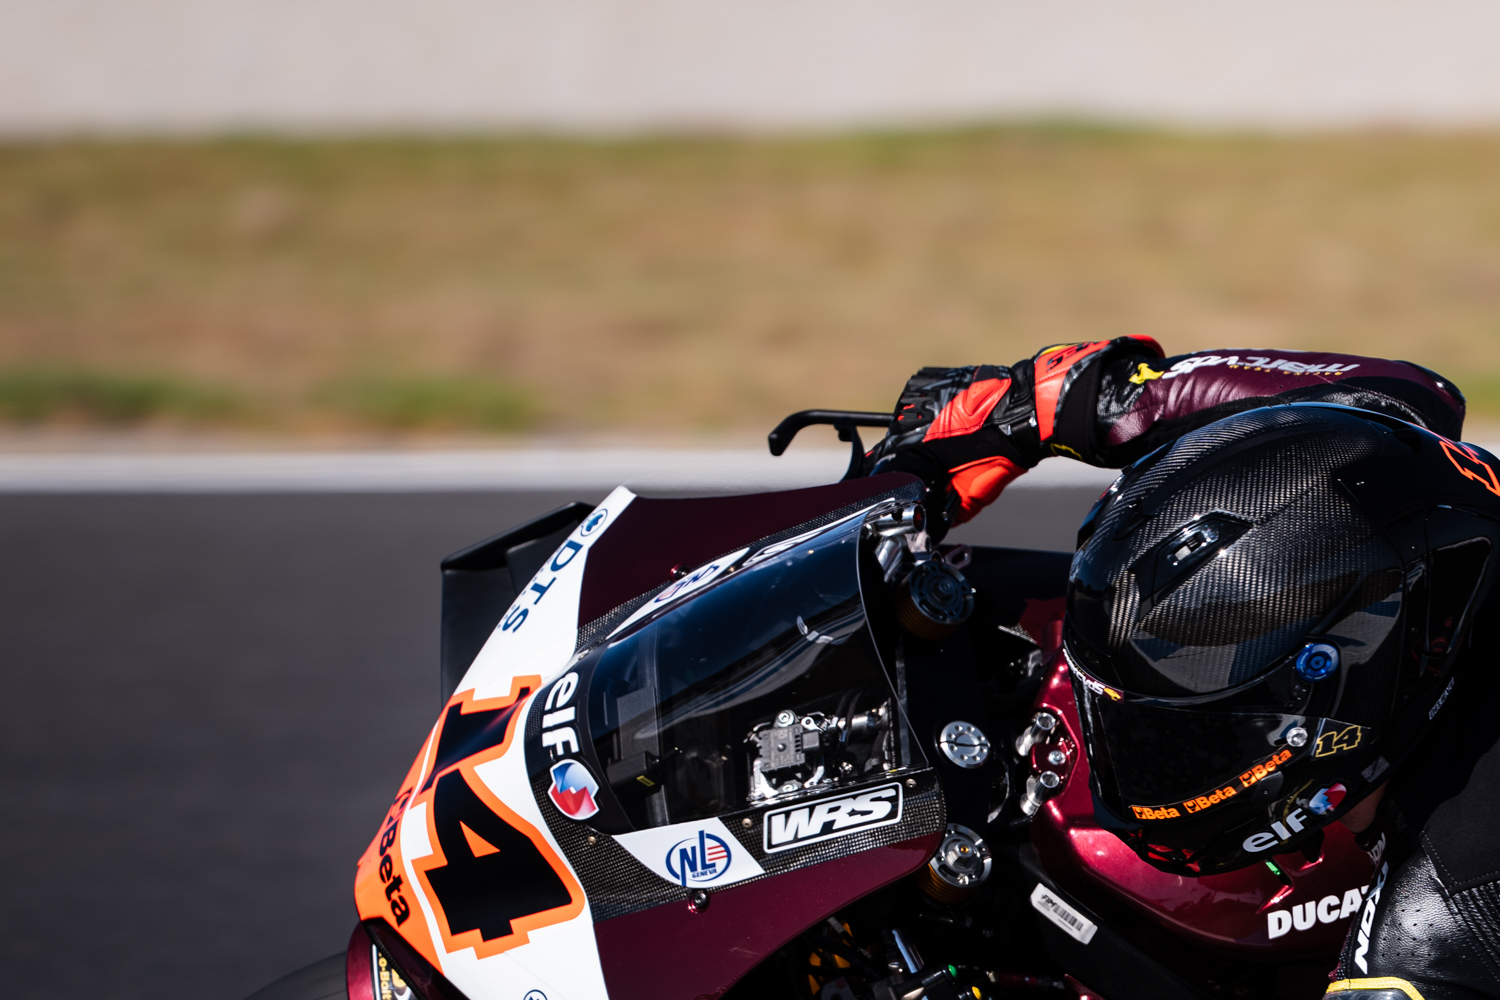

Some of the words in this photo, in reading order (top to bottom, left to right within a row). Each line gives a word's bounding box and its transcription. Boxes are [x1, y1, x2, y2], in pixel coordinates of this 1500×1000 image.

[501, 539, 584, 633] DTS
[541, 671, 581, 756] elf
[1252, 749, 1293, 780] Beta
[1315, 725, 1362, 758] 14
[415, 680, 578, 948] 14
[770, 788, 897, 846] WRS
[1145, 805, 1181, 820] Beta
[1198, 785, 1237, 809] Beta
[1242, 808, 1311, 853] elf
[379, 815, 411, 927] Beta
[678, 830, 717, 887] NL
[691, 868, 718, 879] GENEVA
[1267, 885, 1370, 940] DUCA
